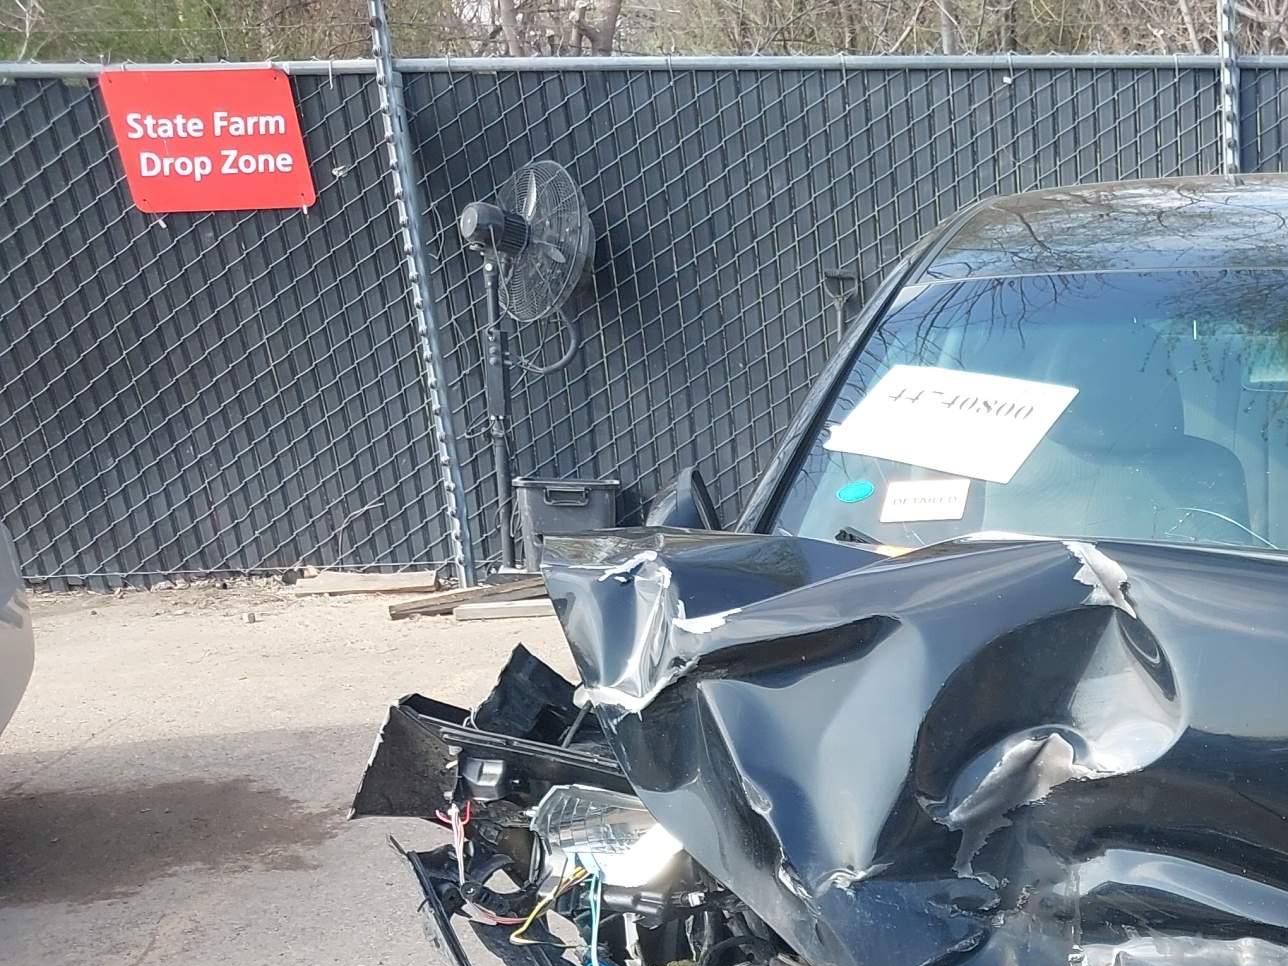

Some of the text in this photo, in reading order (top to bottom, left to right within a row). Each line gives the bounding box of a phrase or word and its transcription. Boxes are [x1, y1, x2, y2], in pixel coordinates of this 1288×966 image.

[126, 111, 286, 139] State Farm
[139, 149, 293, 181] Drop Zone
